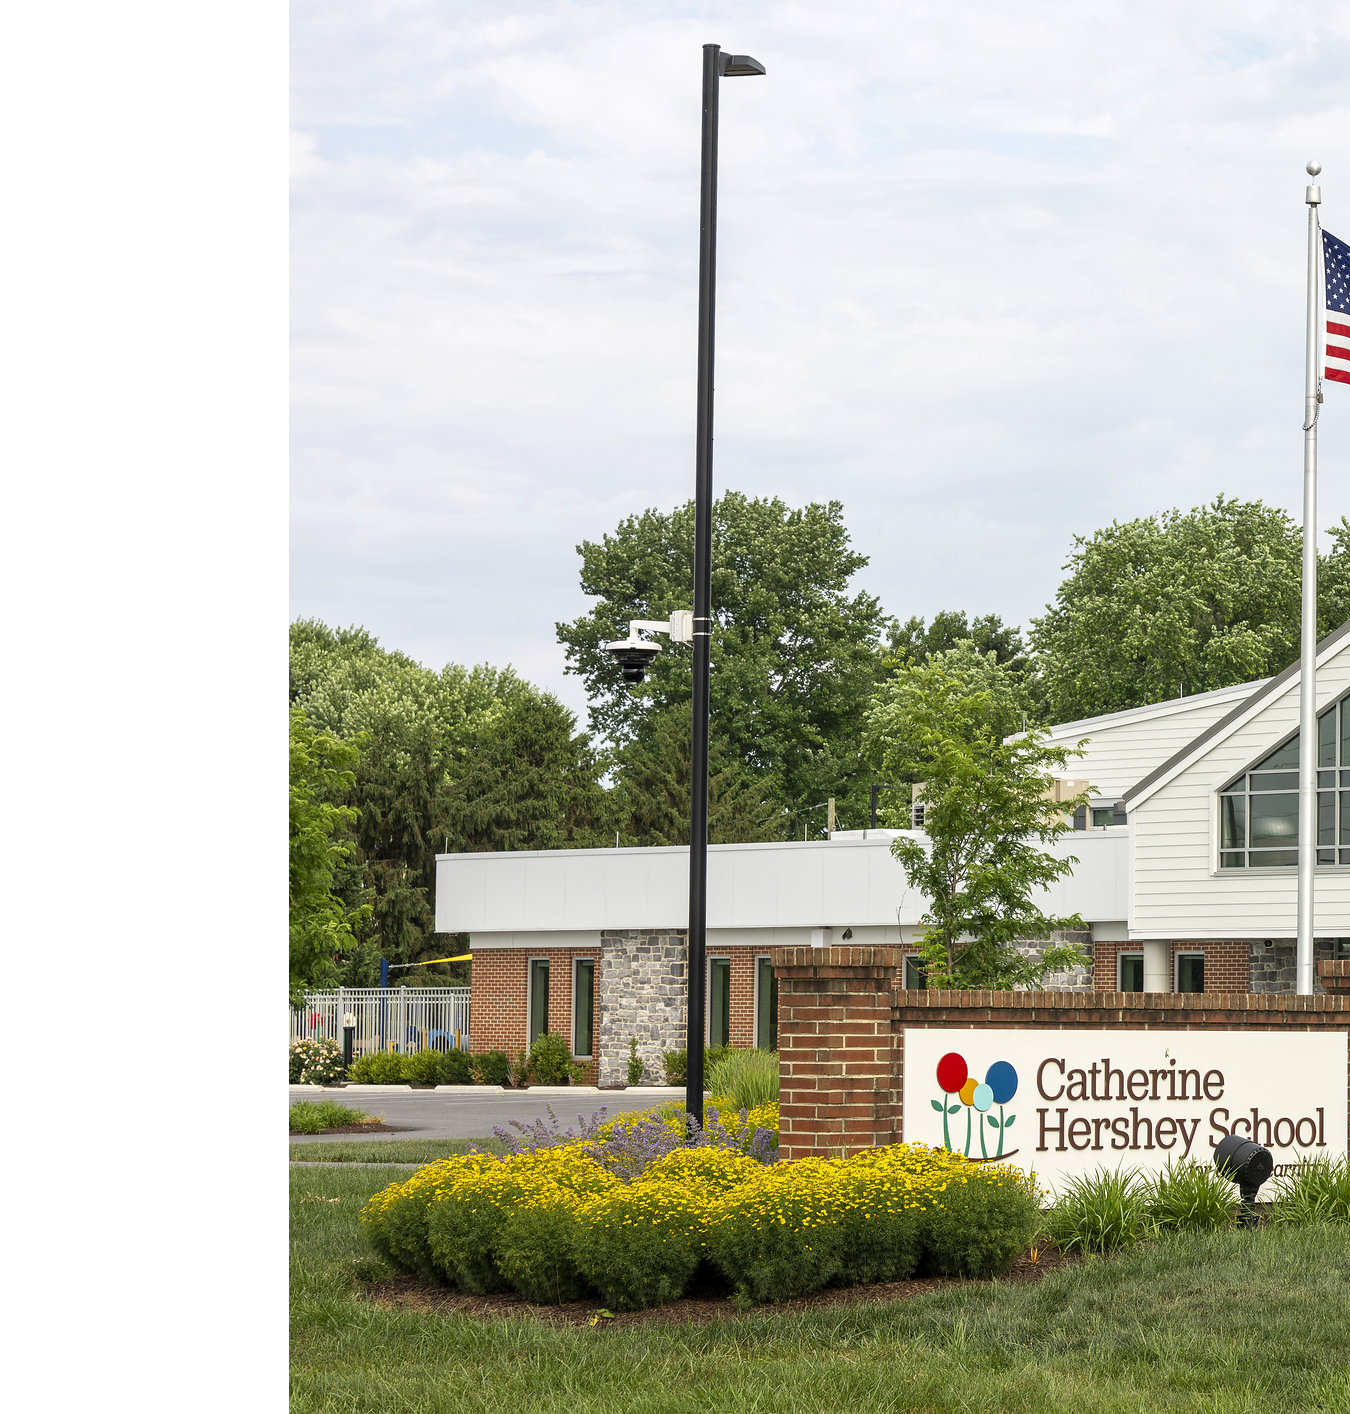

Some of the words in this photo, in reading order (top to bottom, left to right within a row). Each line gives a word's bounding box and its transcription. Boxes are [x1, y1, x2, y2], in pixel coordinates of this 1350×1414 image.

[1036, 1058, 1225, 1101] Catherine
[1036, 1107, 1201, 1158] Hershey
[1209, 1107, 1327, 1148] School
